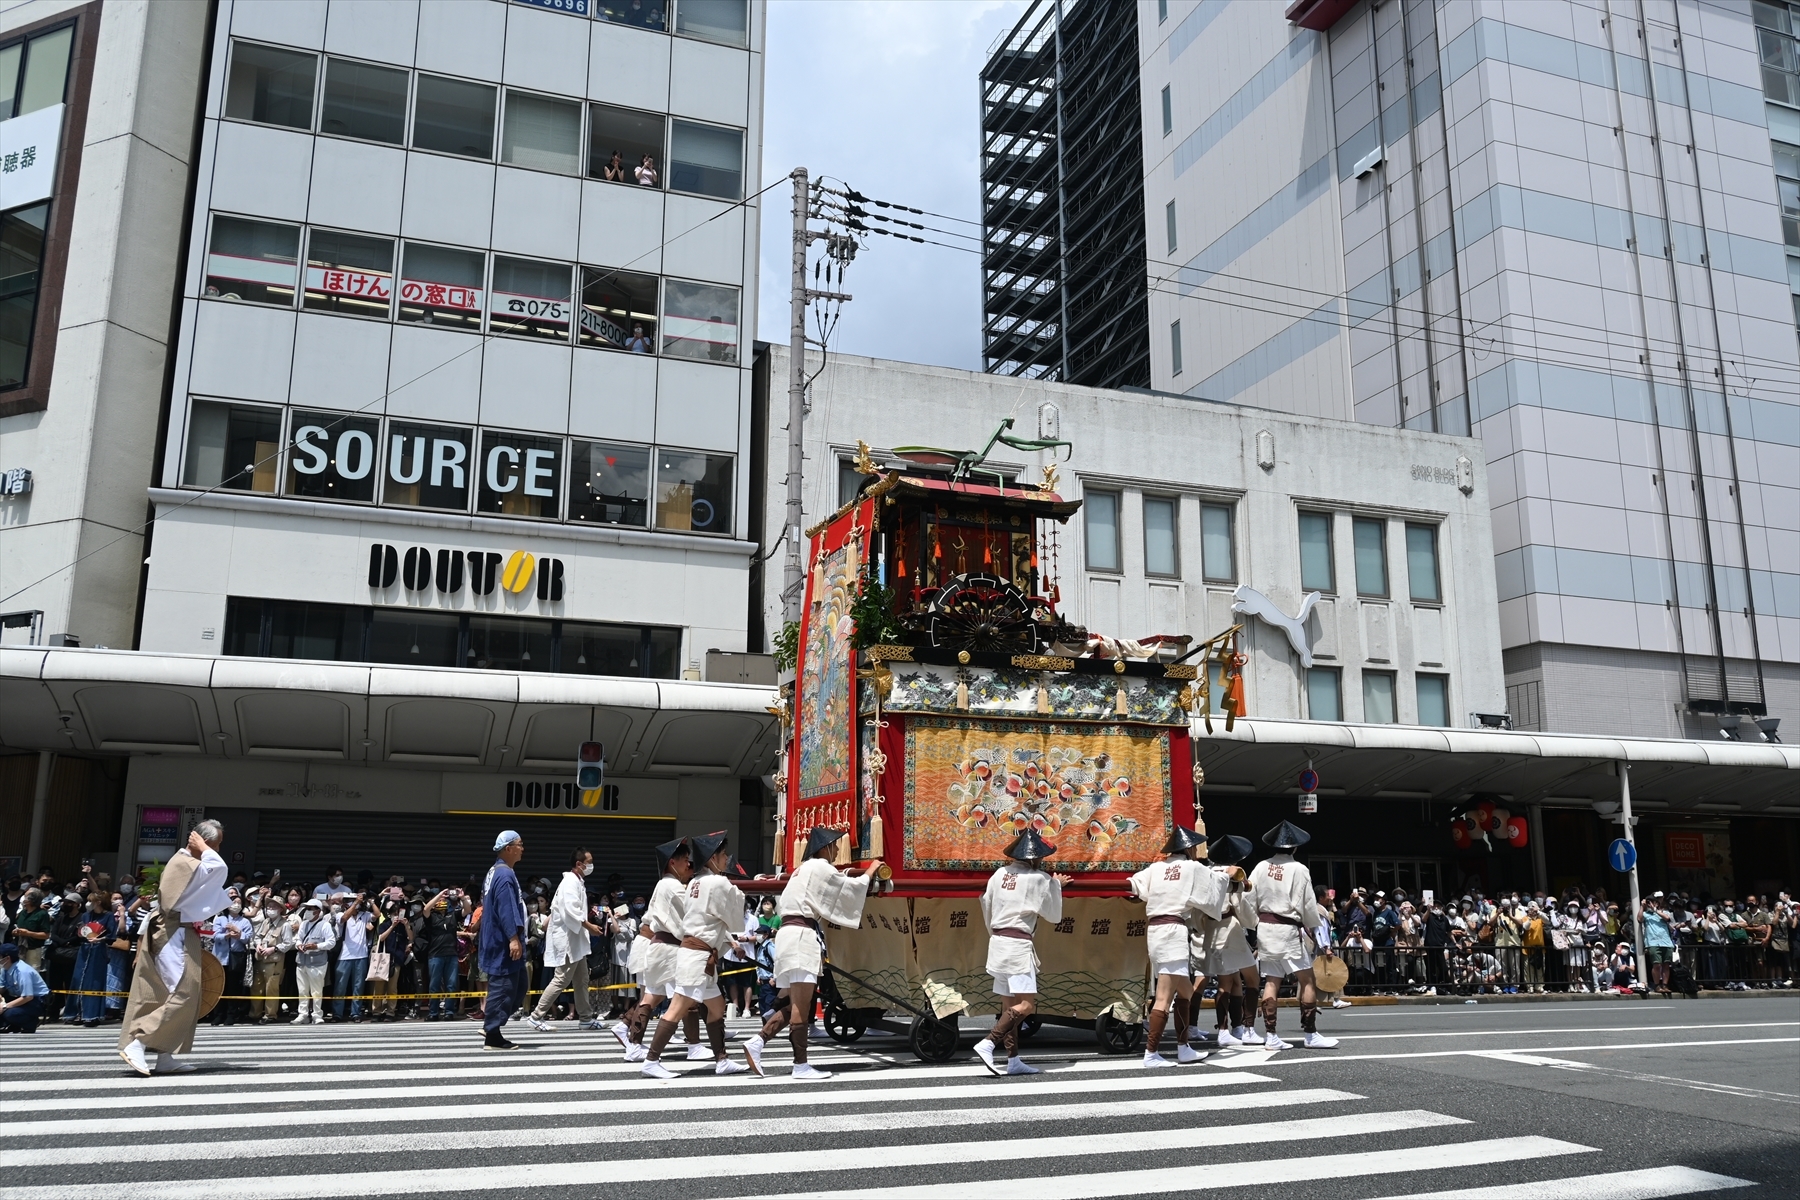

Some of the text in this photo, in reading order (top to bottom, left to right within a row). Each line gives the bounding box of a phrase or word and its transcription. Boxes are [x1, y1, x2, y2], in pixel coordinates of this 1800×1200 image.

[0, 145, 37, 175] 聴器
[292, 425, 555, 497] SOURCE
[368, 543, 565, 602] DOUTOR
[506, 781, 619, 811] DOUTOR
[1675, 842, 1695, 850] DECO
[1676, 850, 1696, 858] HOME
